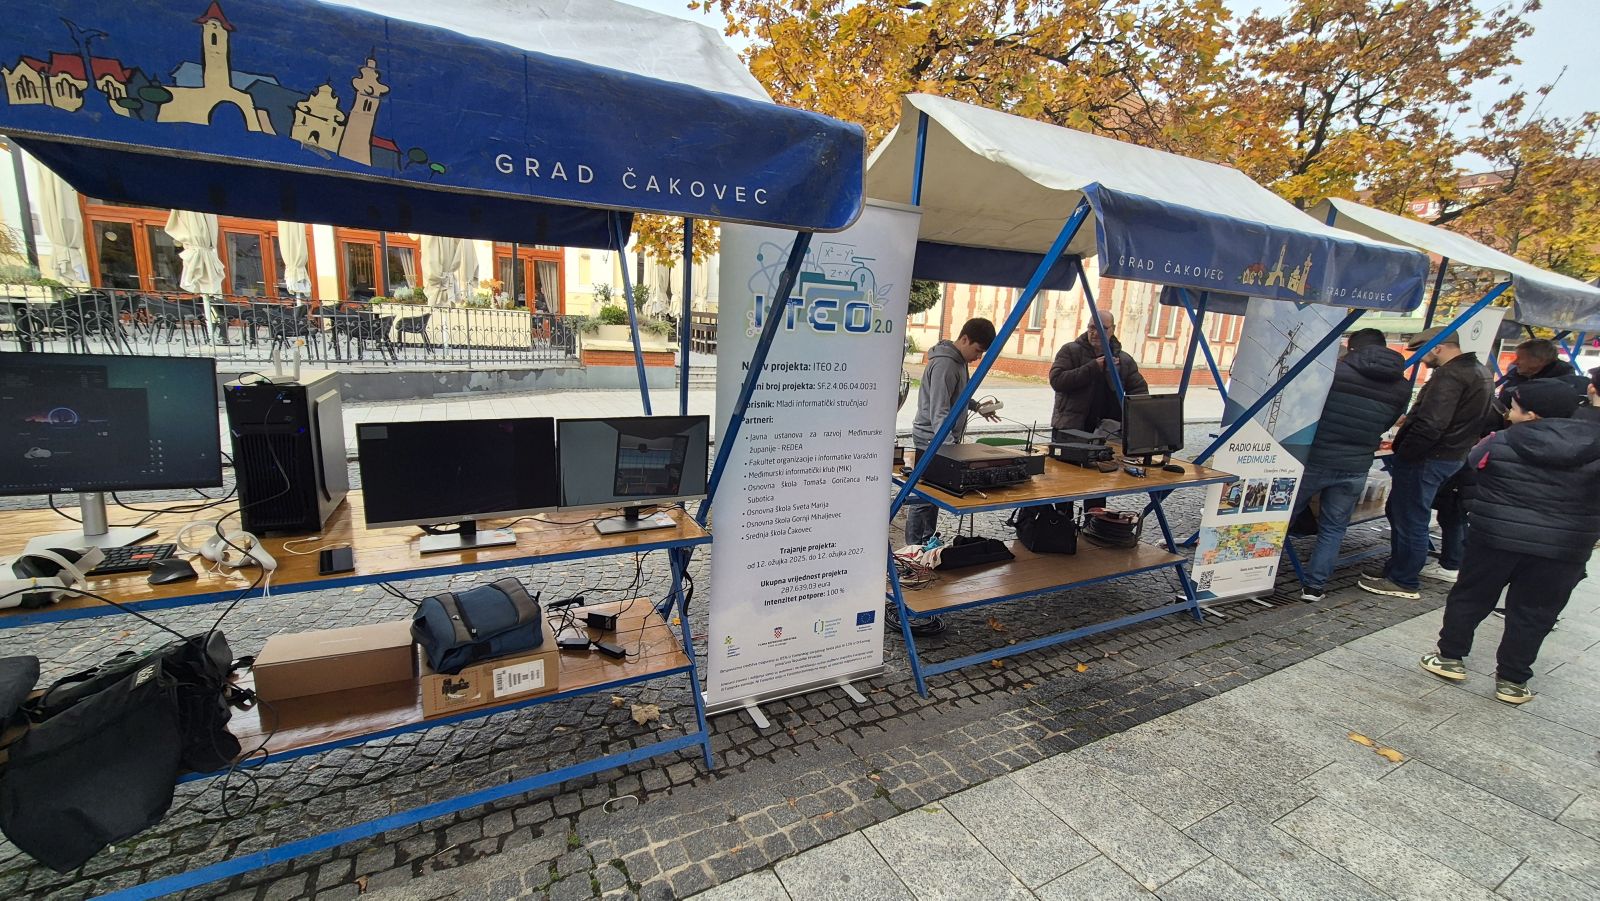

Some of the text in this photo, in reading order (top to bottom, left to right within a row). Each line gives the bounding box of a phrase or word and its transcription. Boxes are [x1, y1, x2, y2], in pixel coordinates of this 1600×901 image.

[495, 154, 768, 205] GRAD ČAKOVEC
[1119, 256, 1224, 280] GRAD ČAKOVEC
[874, 319, 892, 334] 2.0
[771, 362, 811, 372] projekta:
[814, 363, 831, 371] ITEO
[834, 363, 847, 371] 2.0
[766, 382, 780, 392] broj
[782, 382, 815, 391] projekta:
[747, 400, 774, 408] orisnik:
[776, 400, 795, 408] Mladi
[837, 399, 868, 408] stručnjaci
[750, 433, 768, 442] Javna
[824, 430, 842, 438] razvoj
[749, 446, 776, 454] županije
[1229, 443, 1271, 452] RADIO KLUB
[777, 455, 813, 465] organizacije
[748, 470, 784, 479] Međimurski
[785, 466, 822, 475] informatički
[836, 464, 852, 473] (MIK)
[748, 483, 775, 492] Osnovna
[747, 495, 774, 504] Subotica
[746, 508, 774, 516] Osnovna
[746, 520, 773, 528] Osnovna
[792, 515, 810, 523] Gornji
[811, 512, 842, 521] Mihaljevec
[745, 532, 769, 541] Srednja
[787, 526, 812, 535] Čakovec
[780, 542, 836, 554] Trajanje projekta:
[768, 558, 788, 567] ožujka
[829, 550, 847, 558] ožujka
[760, 569, 847, 588] Ukupna vrijednost projekta
[764, 596, 797, 606] Intenzitet
[798, 592, 826, 602] potpore:
